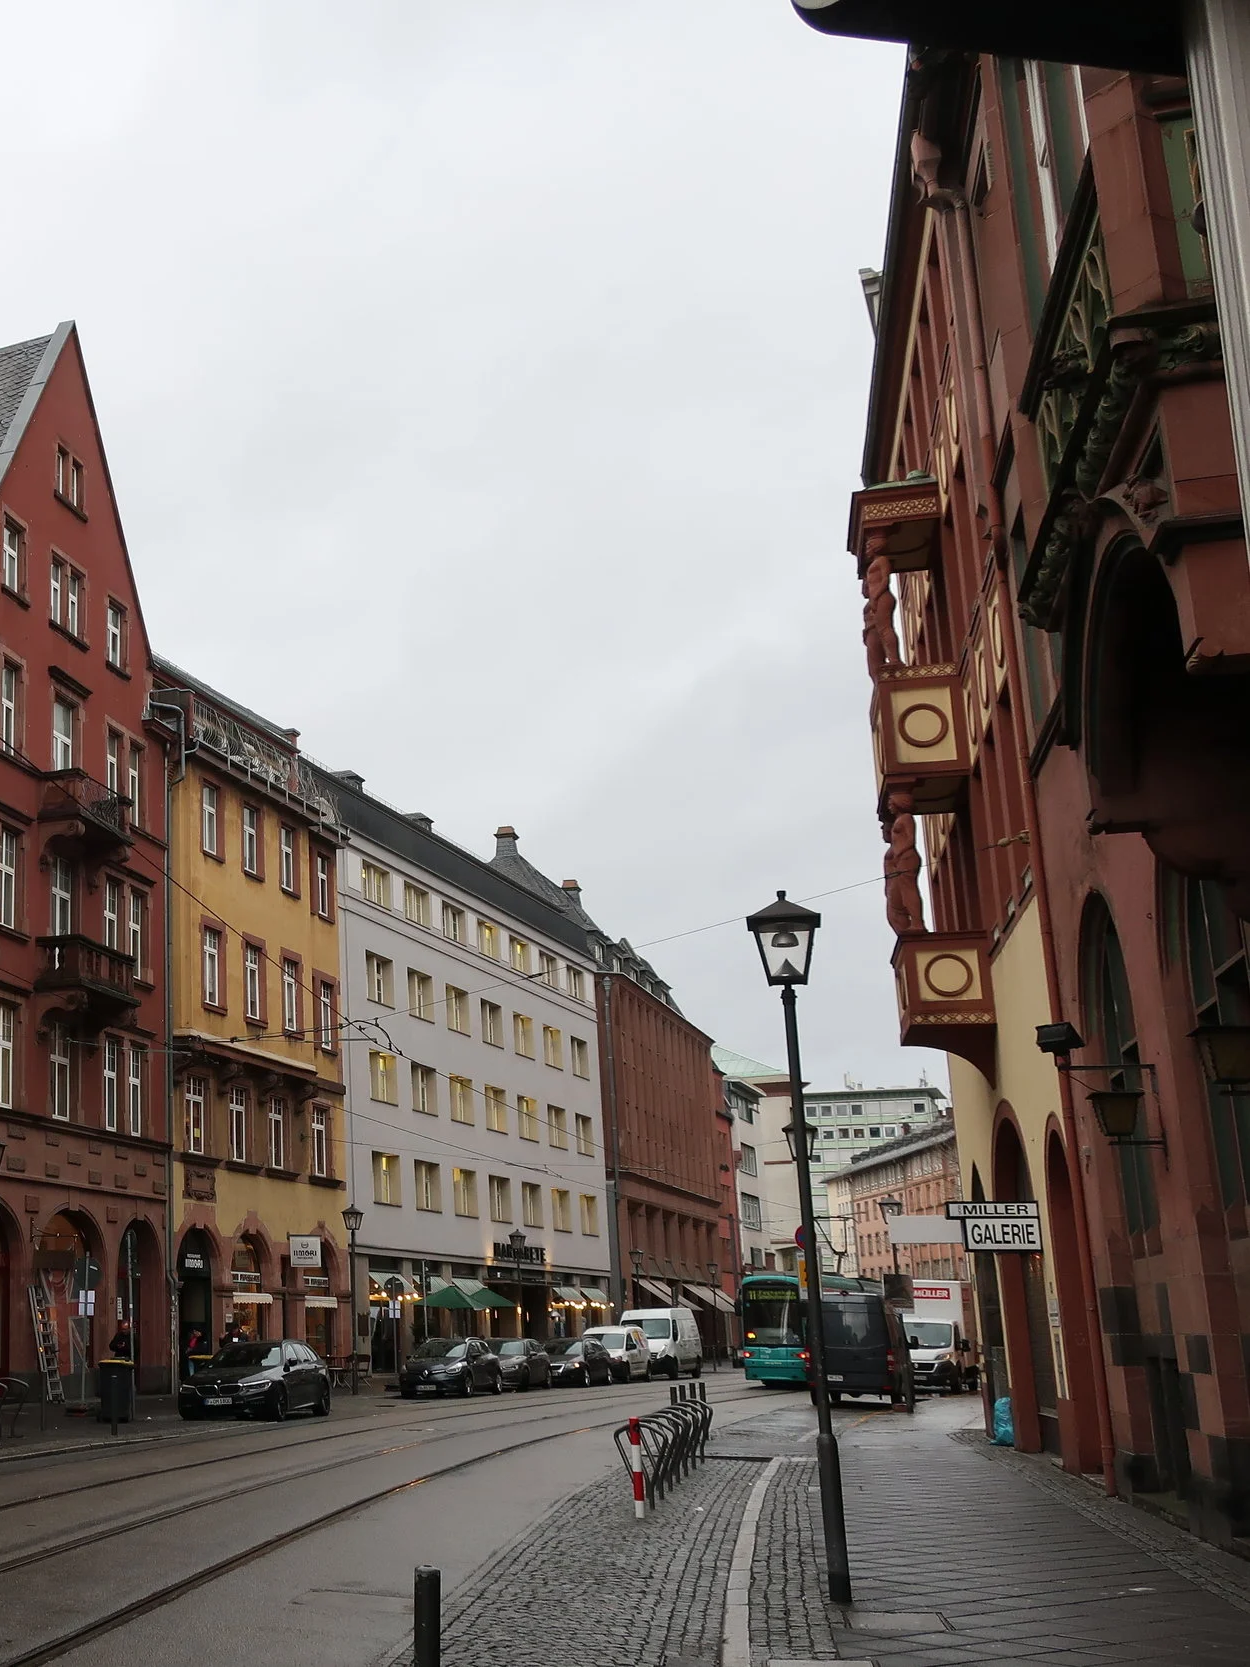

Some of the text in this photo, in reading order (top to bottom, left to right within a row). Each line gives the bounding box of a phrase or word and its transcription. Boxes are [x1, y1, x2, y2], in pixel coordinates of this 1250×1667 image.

[962, 1204, 1029, 1215] MILLER
[971, 1223, 1036, 1245] GALERIE
[749, 1290, 757, 1300] 11
